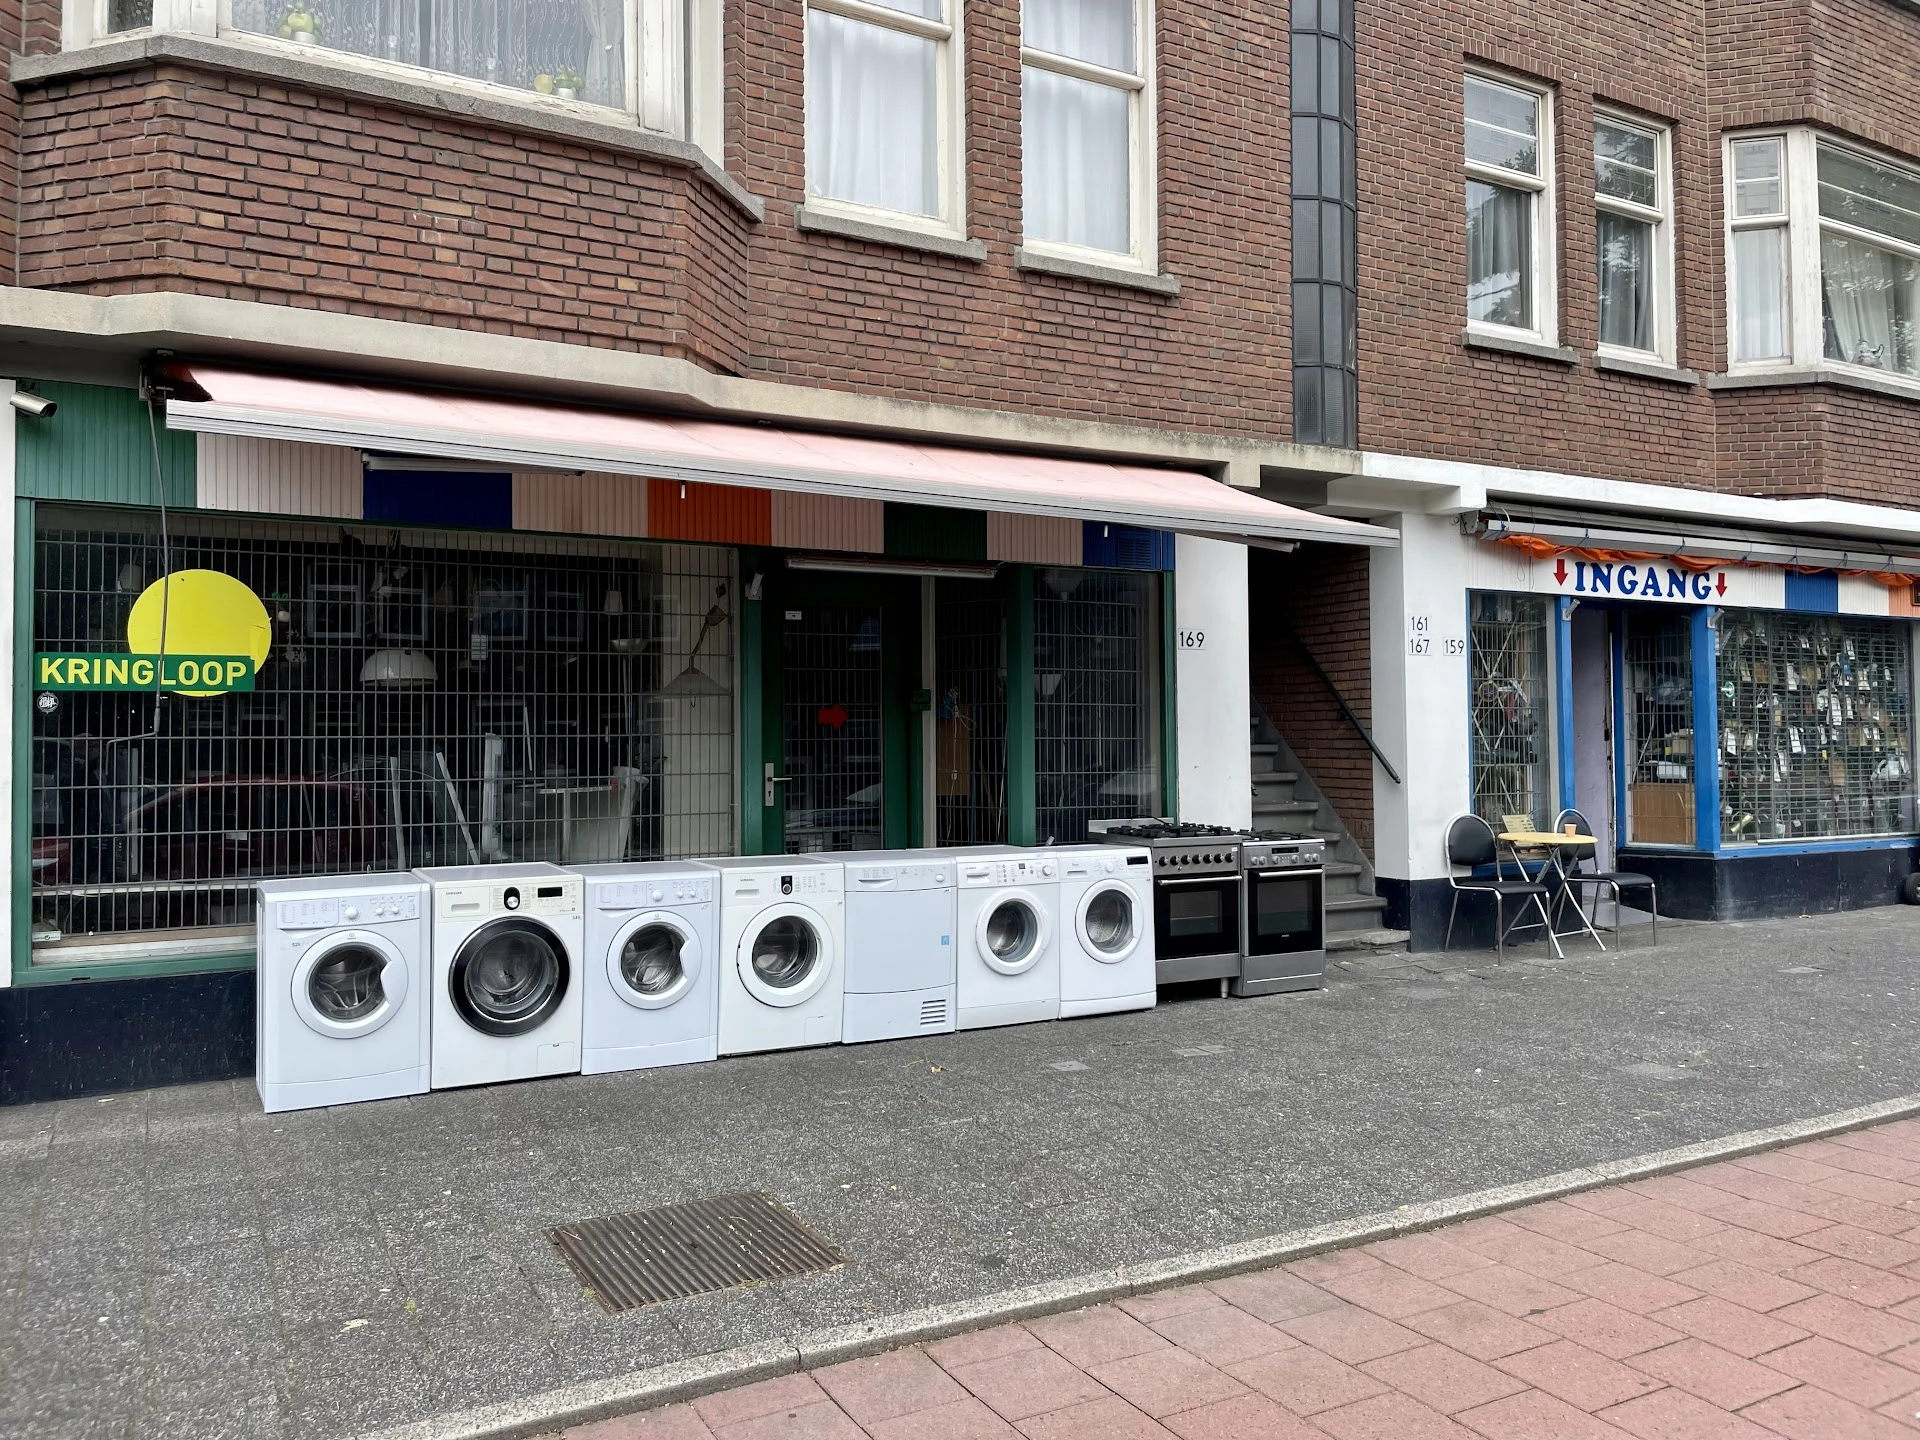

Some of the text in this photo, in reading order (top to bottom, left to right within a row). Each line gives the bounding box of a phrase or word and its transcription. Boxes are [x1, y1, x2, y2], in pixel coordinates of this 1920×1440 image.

[1574, 561, 1712, 600] INGANG
[1411, 616, 1428, 631] 161
[1179, 631, 1205, 648] 169
[1409, 638, 1430, 654] 167
[1445, 639, 1465, 654] 159
[41, 657, 247, 686] KRINGLOOP
